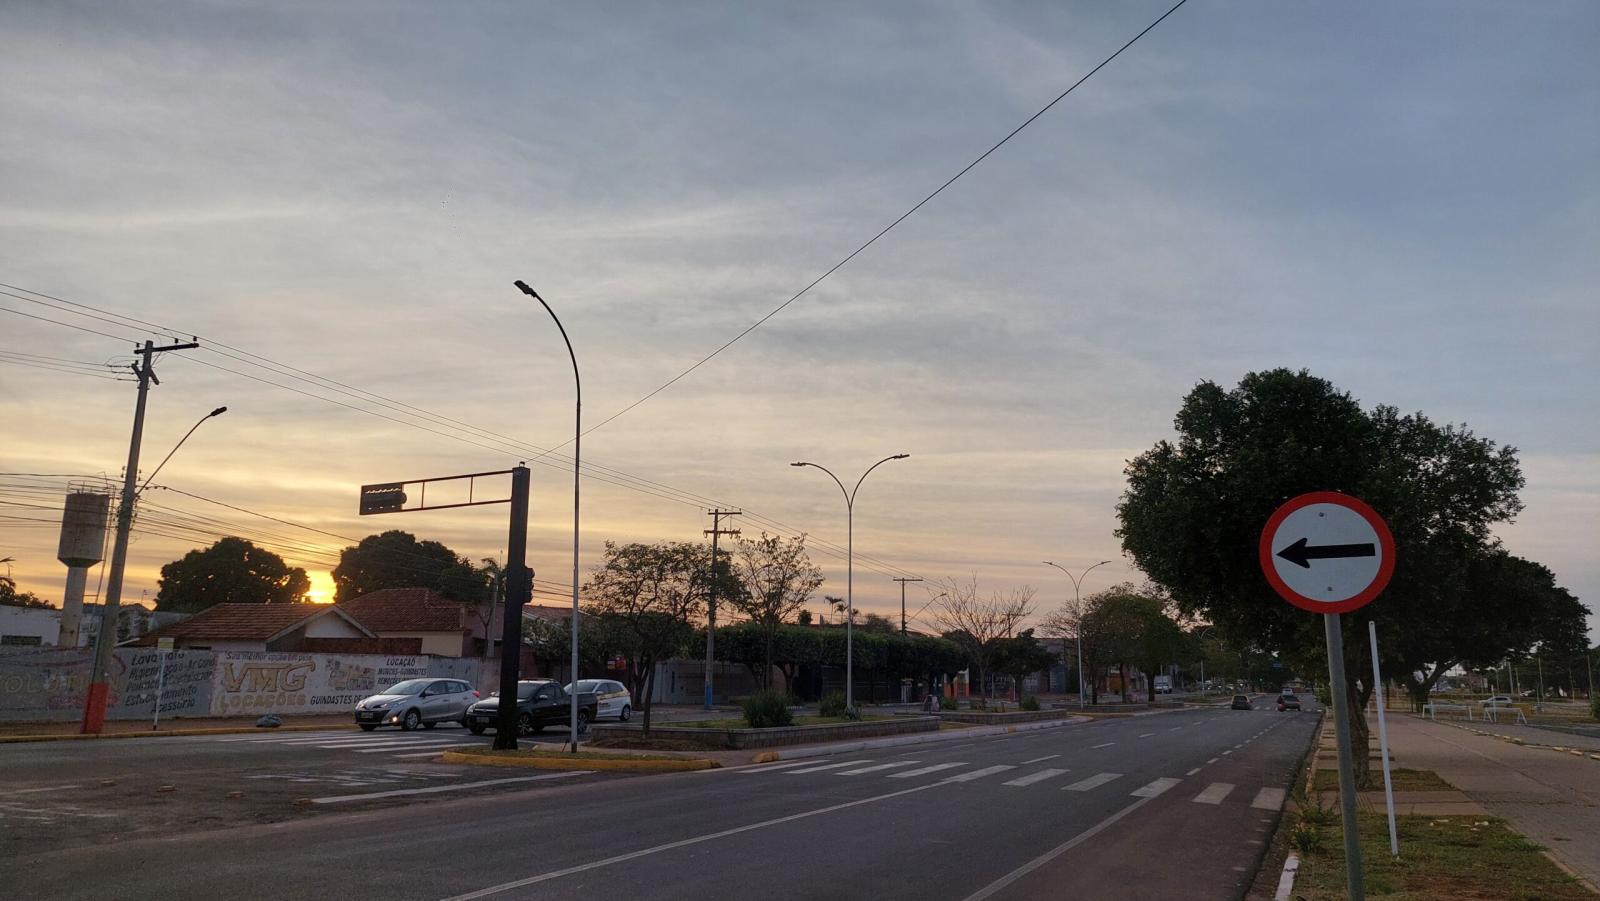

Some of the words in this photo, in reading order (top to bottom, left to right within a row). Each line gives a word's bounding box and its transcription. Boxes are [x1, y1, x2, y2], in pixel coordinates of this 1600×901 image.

[131, 654, 158, 666] Lava
[386, 657, 416, 667] LOCAÇÃO
[223, 662, 316, 693] VMG
[310, 695, 352, 705] GUINDASTES
